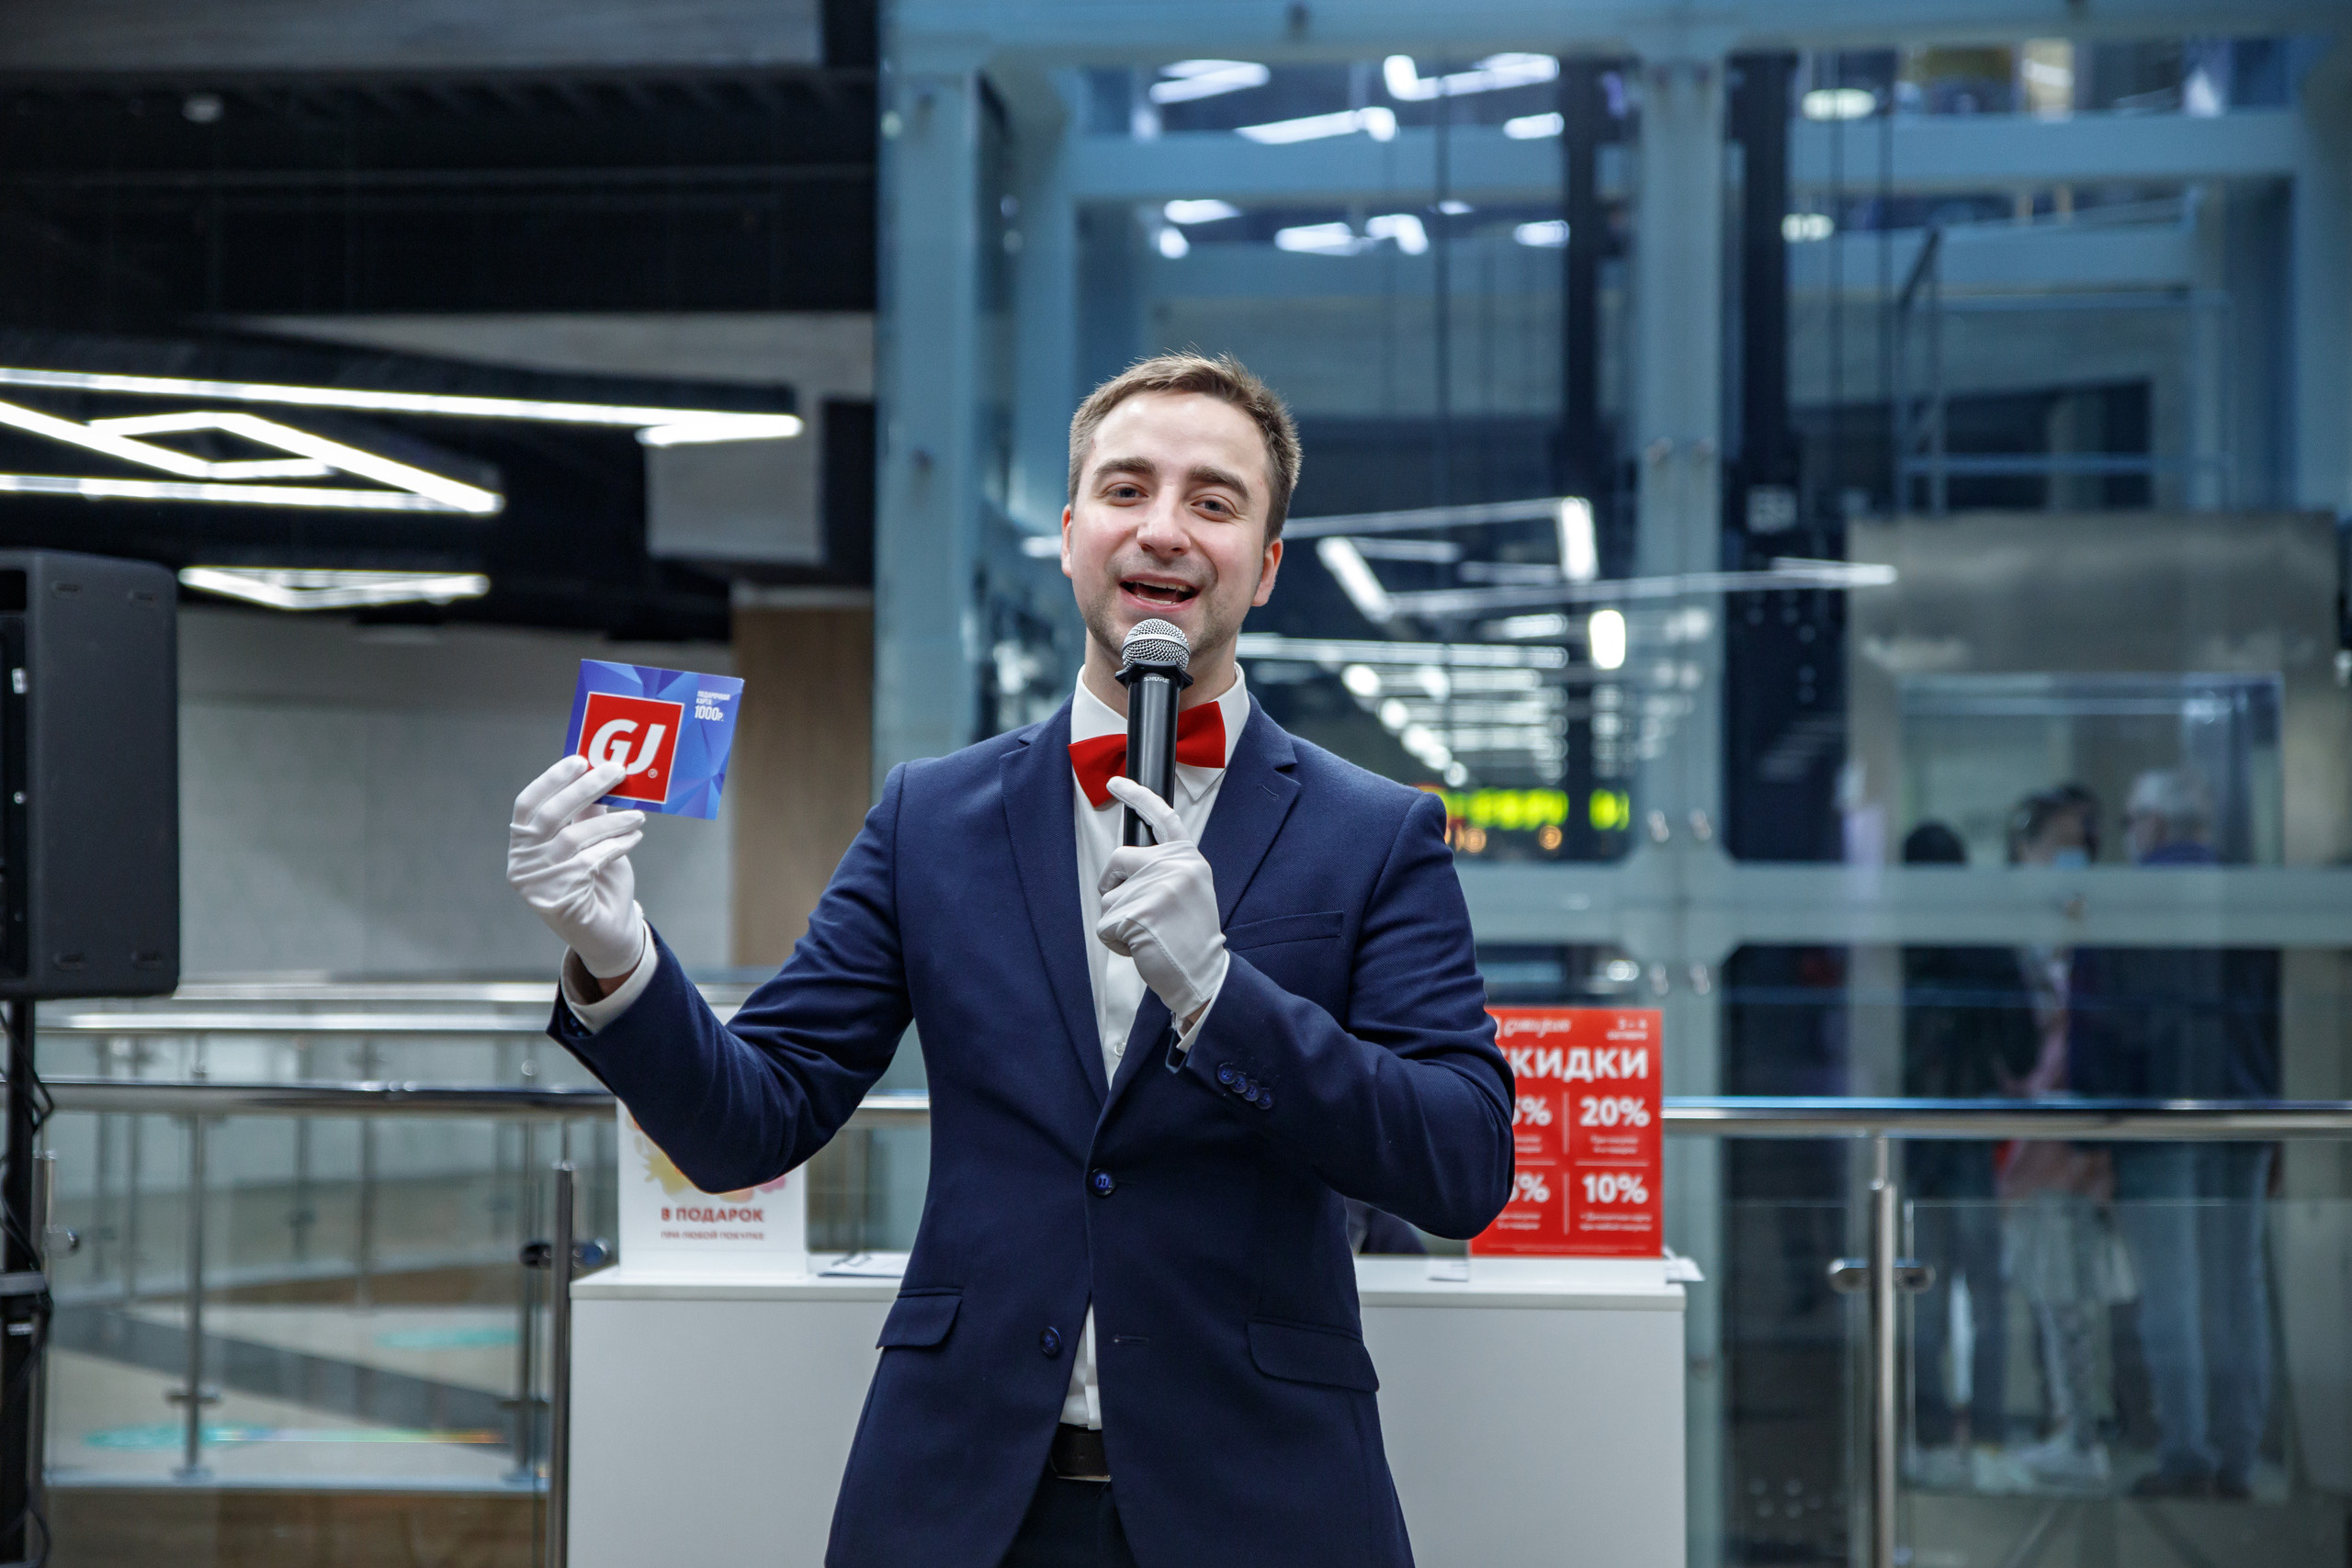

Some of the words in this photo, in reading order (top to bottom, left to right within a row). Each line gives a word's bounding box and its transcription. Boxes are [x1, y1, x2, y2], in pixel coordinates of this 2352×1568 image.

[588, 718, 667, 775] GJ
[1502, 1045, 1649, 1083] КИДКИ
[1579, 1096, 1651, 1127] 20%
[1582, 1173, 1649, 1204] 10%
[661, 1207, 671, 1222] В
[675, 1207, 764, 1224] ПОДАРОК
